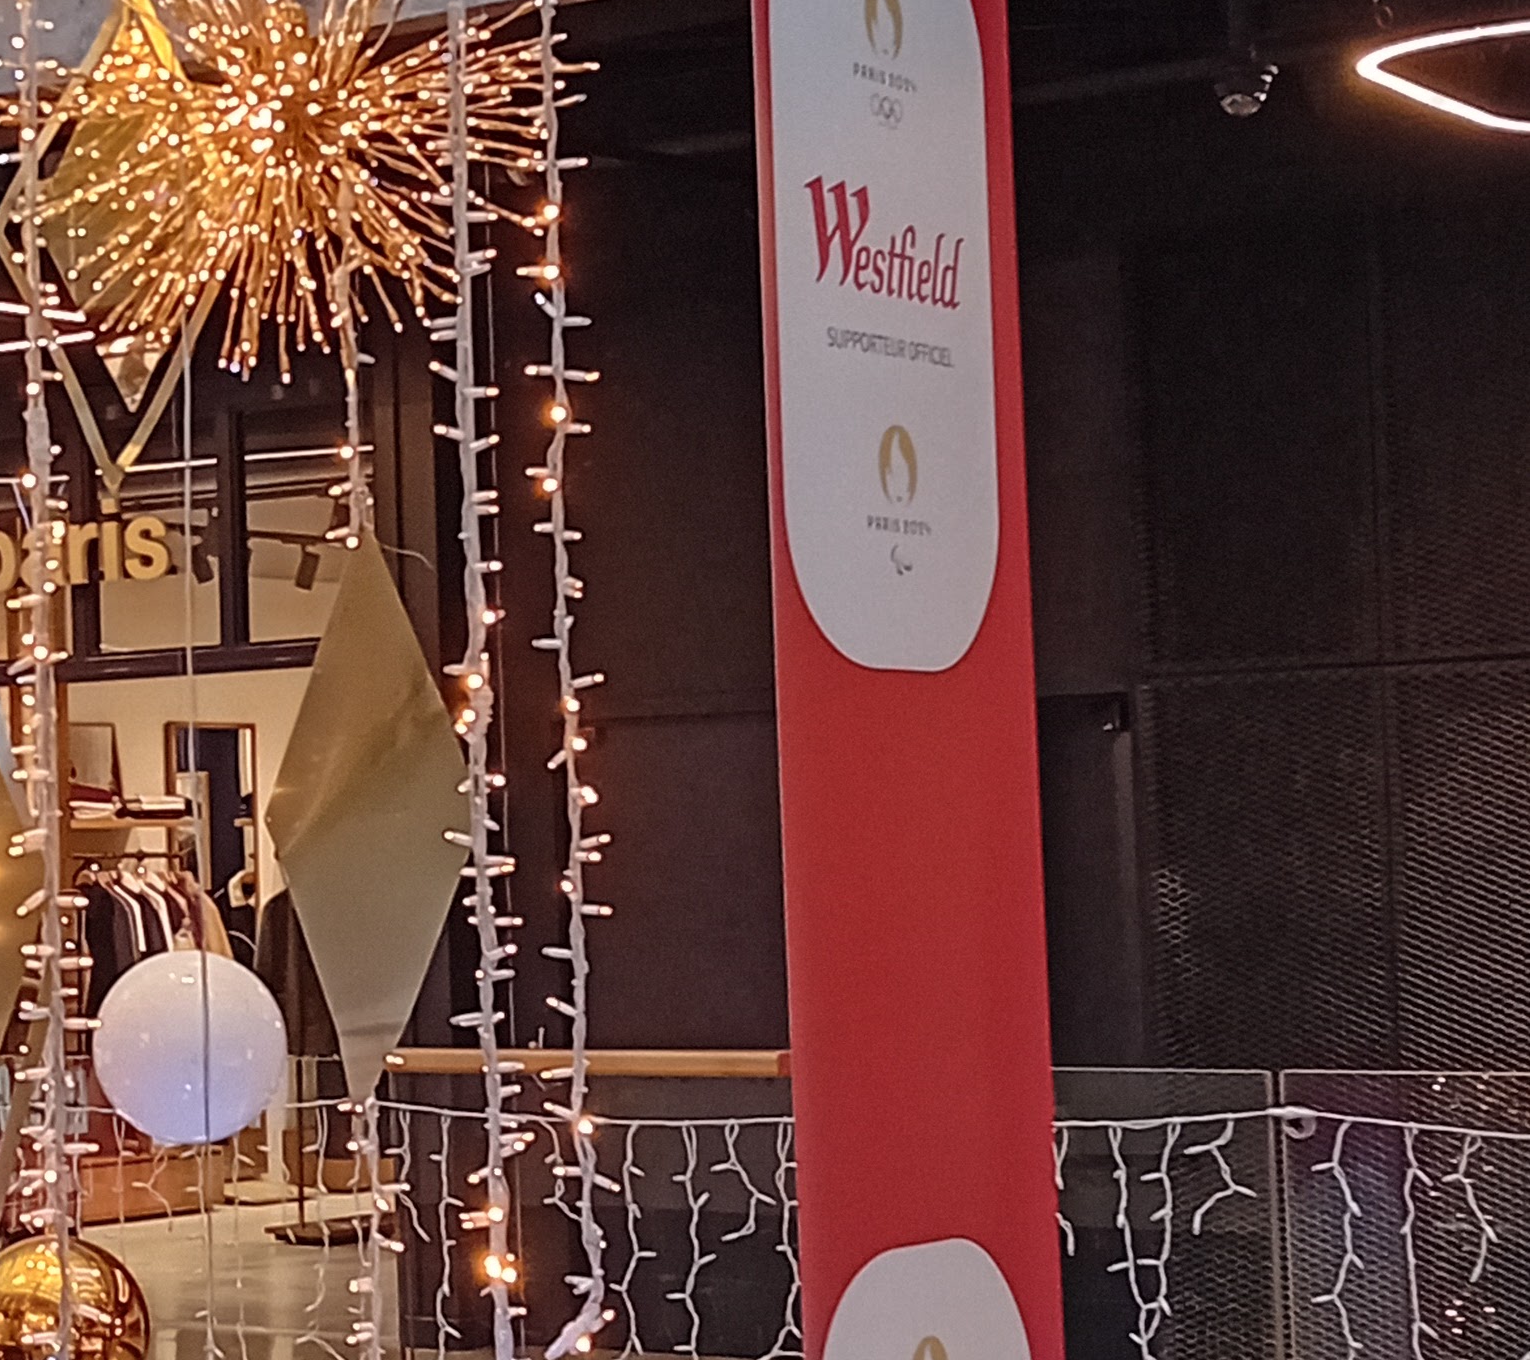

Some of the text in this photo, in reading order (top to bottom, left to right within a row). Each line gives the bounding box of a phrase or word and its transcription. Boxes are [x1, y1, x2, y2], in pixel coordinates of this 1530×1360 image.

[804, 175, 964, 310] Westfield
[827, 326, 955, 368] SUPPORTEUR OFFICIEL
